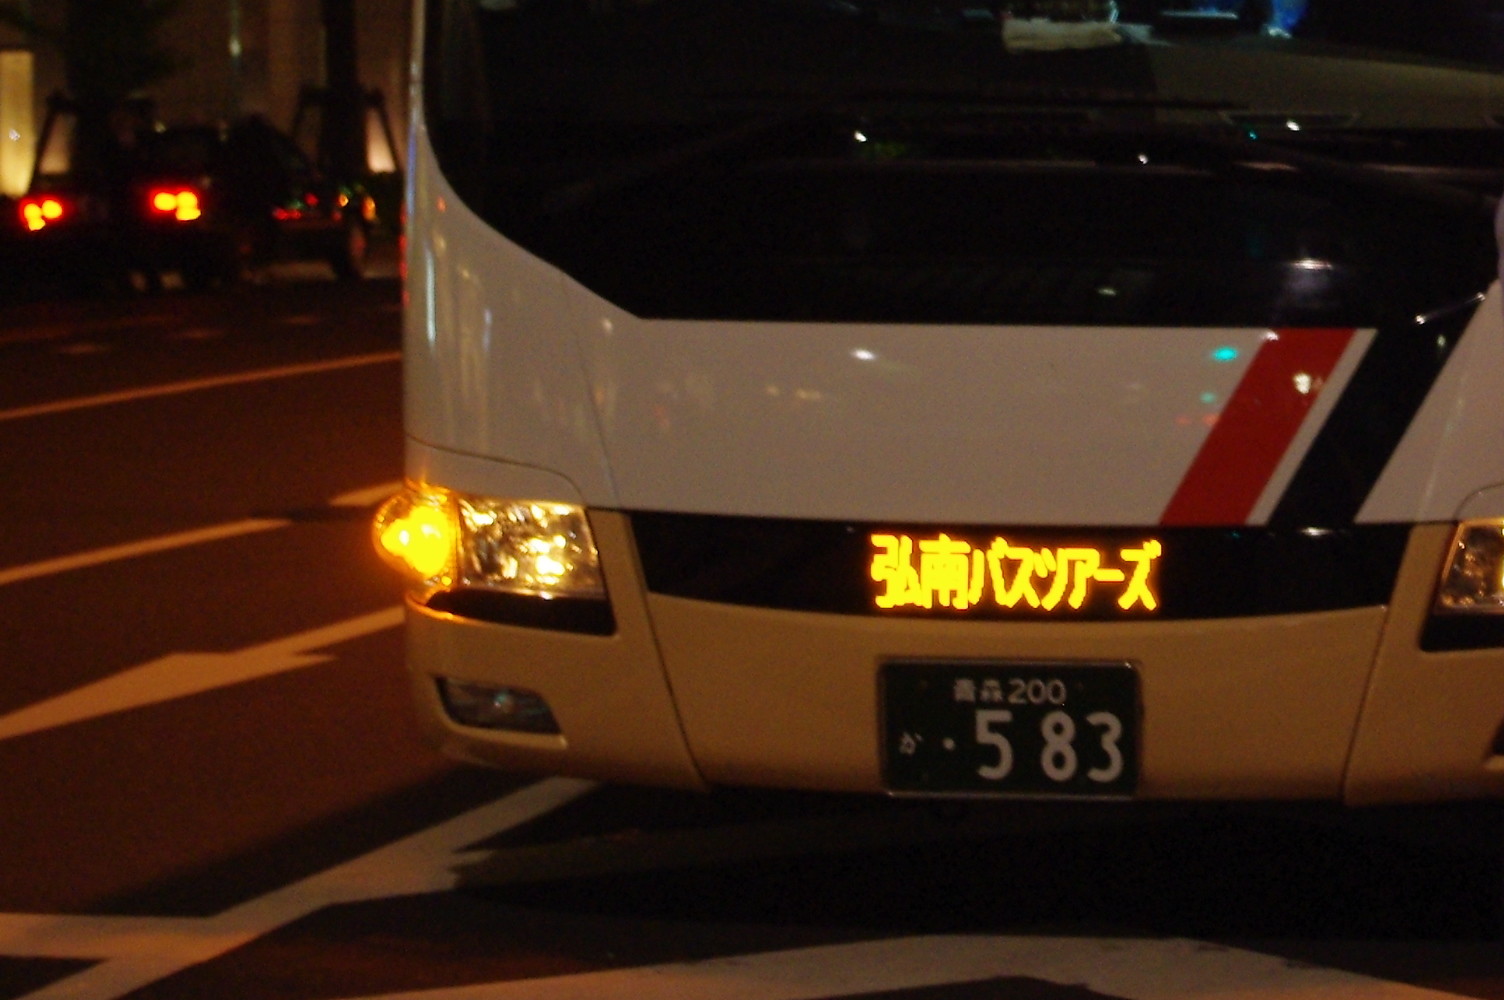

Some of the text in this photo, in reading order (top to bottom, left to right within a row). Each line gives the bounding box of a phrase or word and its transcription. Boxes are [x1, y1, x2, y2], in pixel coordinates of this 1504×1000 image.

[870, 533, 1162, 611] 弘南バスツアーズ
